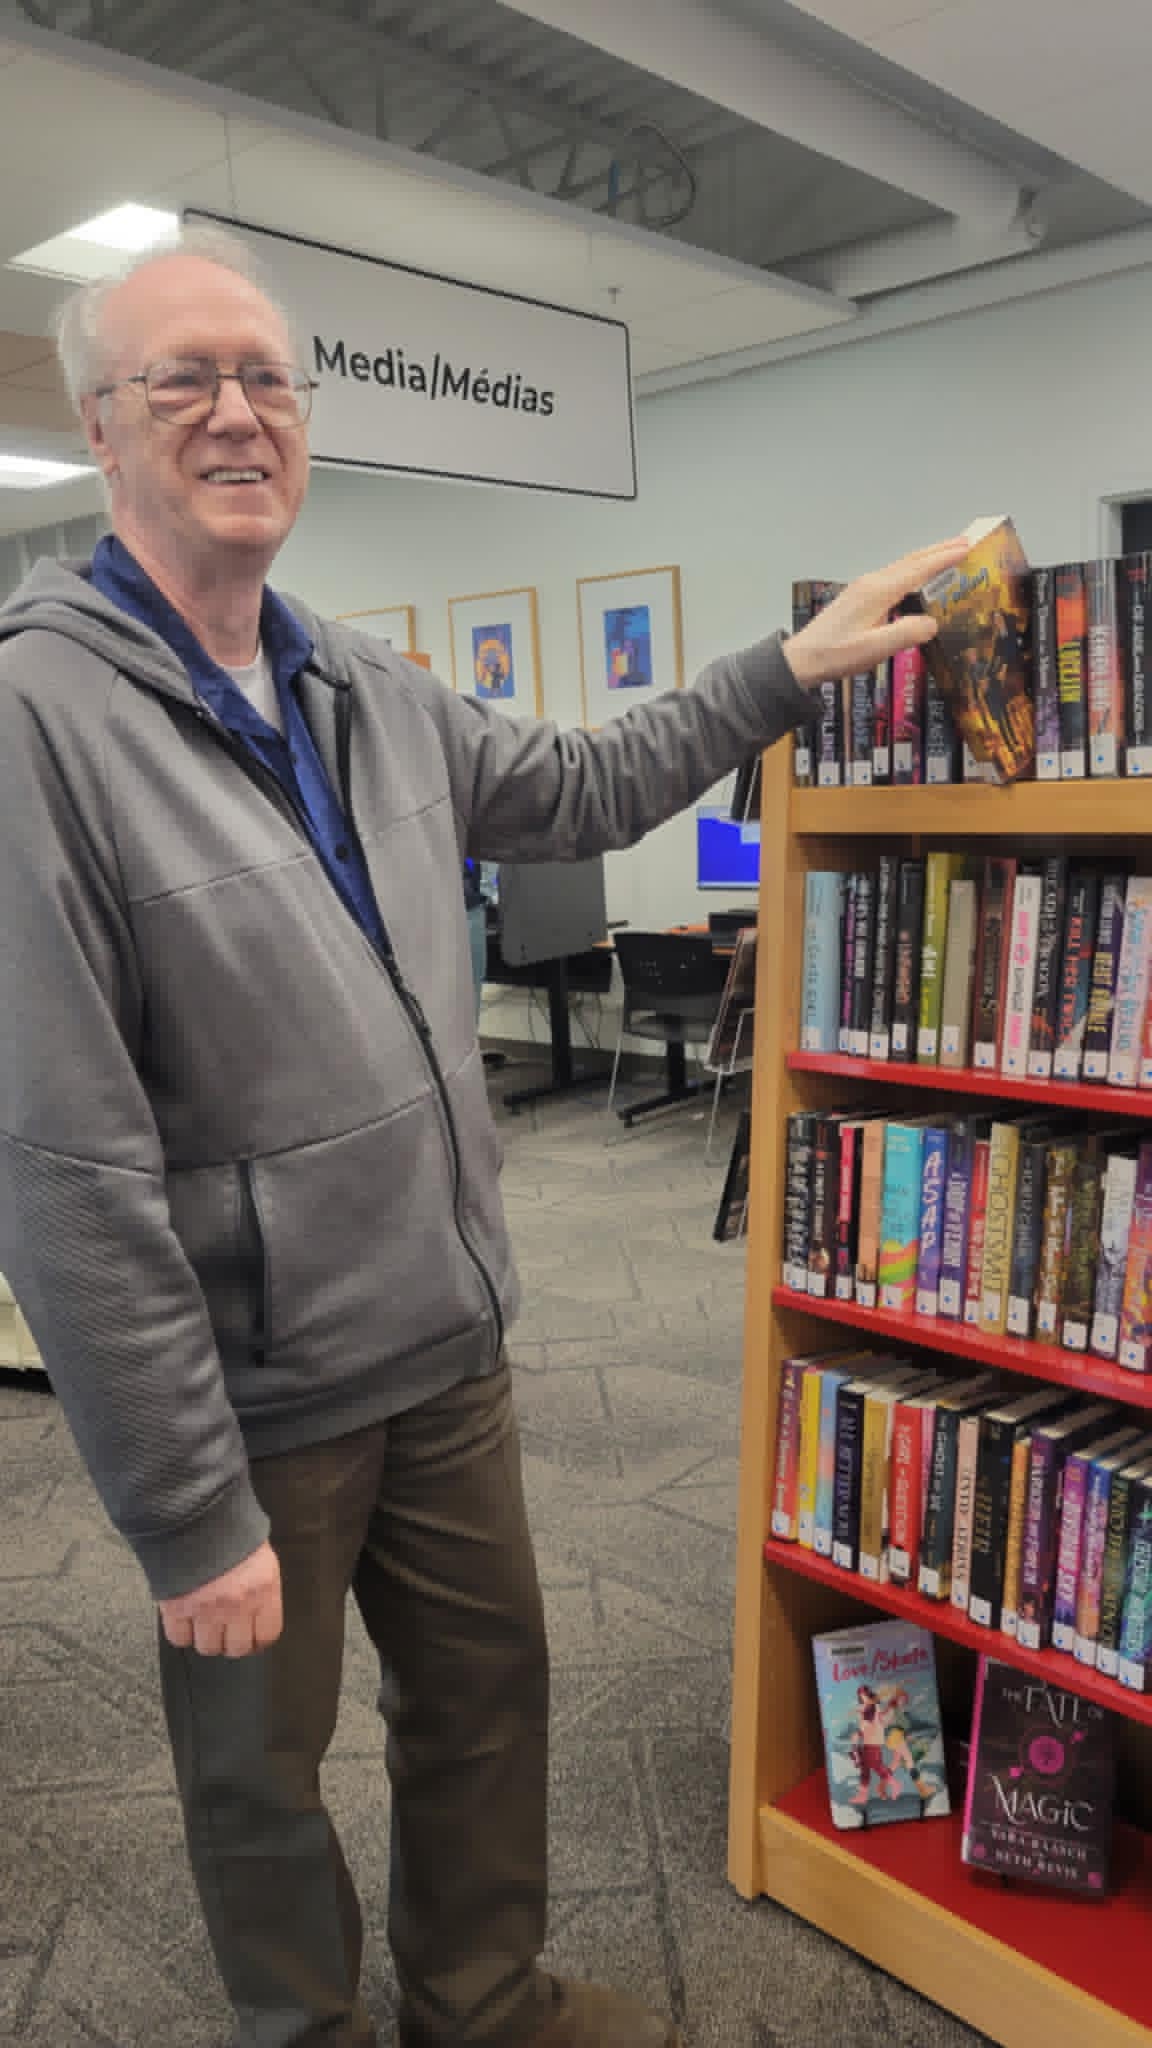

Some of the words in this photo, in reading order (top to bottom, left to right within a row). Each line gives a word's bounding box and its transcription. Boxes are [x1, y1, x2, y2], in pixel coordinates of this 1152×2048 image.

[313, 335, 556, 417] Media/Médias
[1089, 625, 1113, 711] KINDLING
[1064, 955, 1080, 987] HER
[1070, 916, 1084, 948] KILL
[1059, 993, 1077, 1042] TWICE
[919, 1150, 943, 1257] ASAP
[983, 1153, 1010, 1292] GHOSTSMIT
